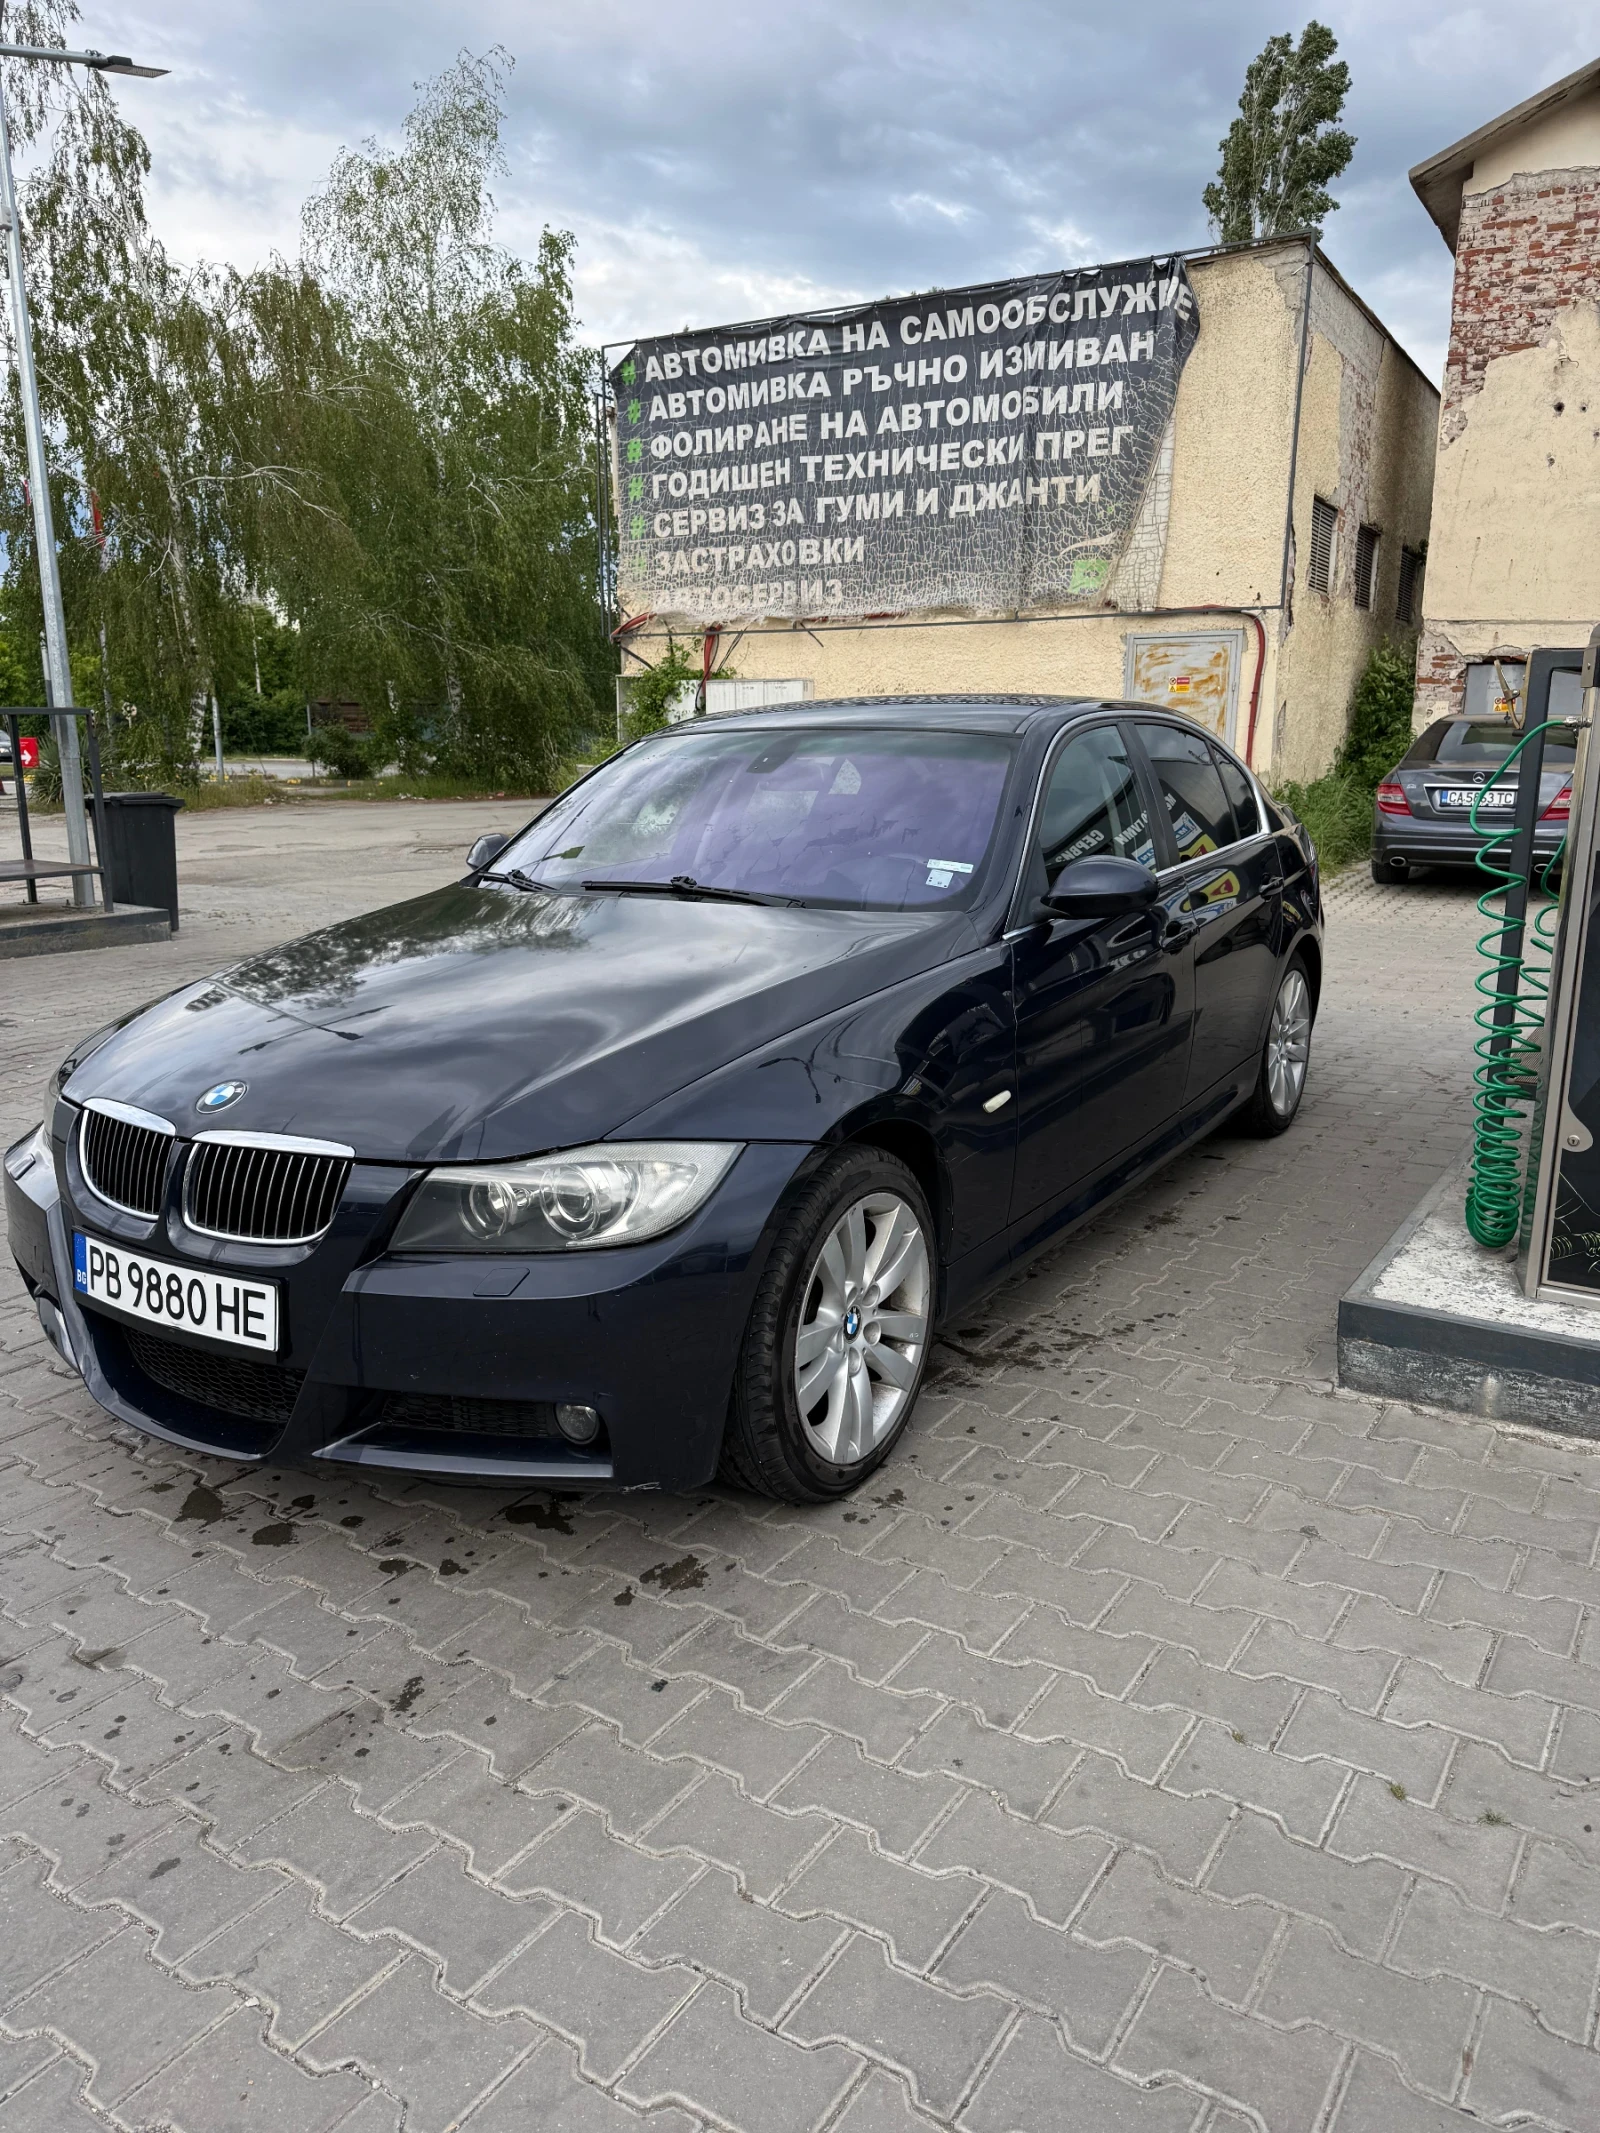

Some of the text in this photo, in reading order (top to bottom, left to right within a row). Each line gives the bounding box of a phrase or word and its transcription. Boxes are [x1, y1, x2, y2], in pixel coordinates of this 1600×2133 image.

[645, 329, 831, 383] АВТОМИВКА
[842, 321, 890, 353] НА
[649, 371, 831, 421] АВТОМИВКА
[843, 354, 968, 396] РЪЧНО
[979, 330, 1155, 380] ИЗМИВАН
[650, 414, 808, 460] ФОЛИРАНЕ
[820, 410, 867, 440] НА
[877, 381, 1124, 434] АВТОМОБИЛИ
[652, 457, 790, 500] ГОДИШЕН
[800, 432, 1025, 483] ТЕХНИЧЕСКИ
[653, 503, 765, 538] СЕРВИЗ
[772, 498, 805, 527] ЗА
[817, 491, 904, 524] ГУМИ
[916, 487, 939, 516] И
[949, 474, 1100, 518] ДЖАНТИ
[655, 536, 865, 577] ЗАСТРАХОВКИ
[76, 1269, 87, 1285] BG
[89, 1245, 267, 1341] PB 9880 HE
